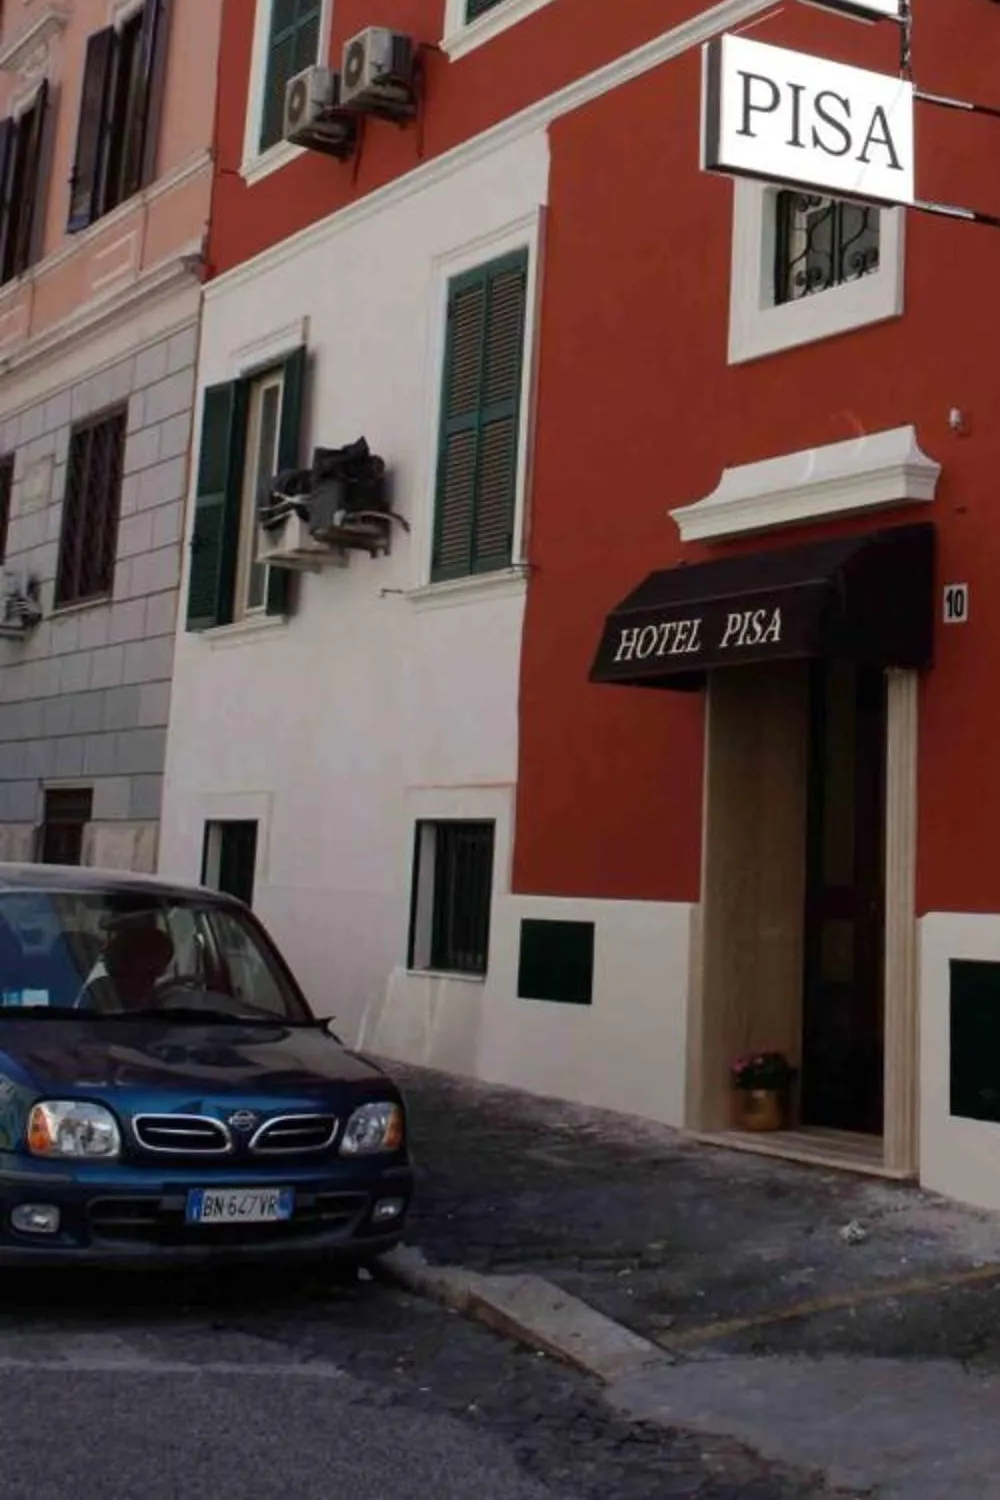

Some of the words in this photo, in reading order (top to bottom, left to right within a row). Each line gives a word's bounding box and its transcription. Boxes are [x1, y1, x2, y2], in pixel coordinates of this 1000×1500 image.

[735, 70, 905, 171] PISA
[946, 589, 965, 618] 10
[613, 619, 702, 662] HOTEL
[719, 607, 782, 648] PISA
